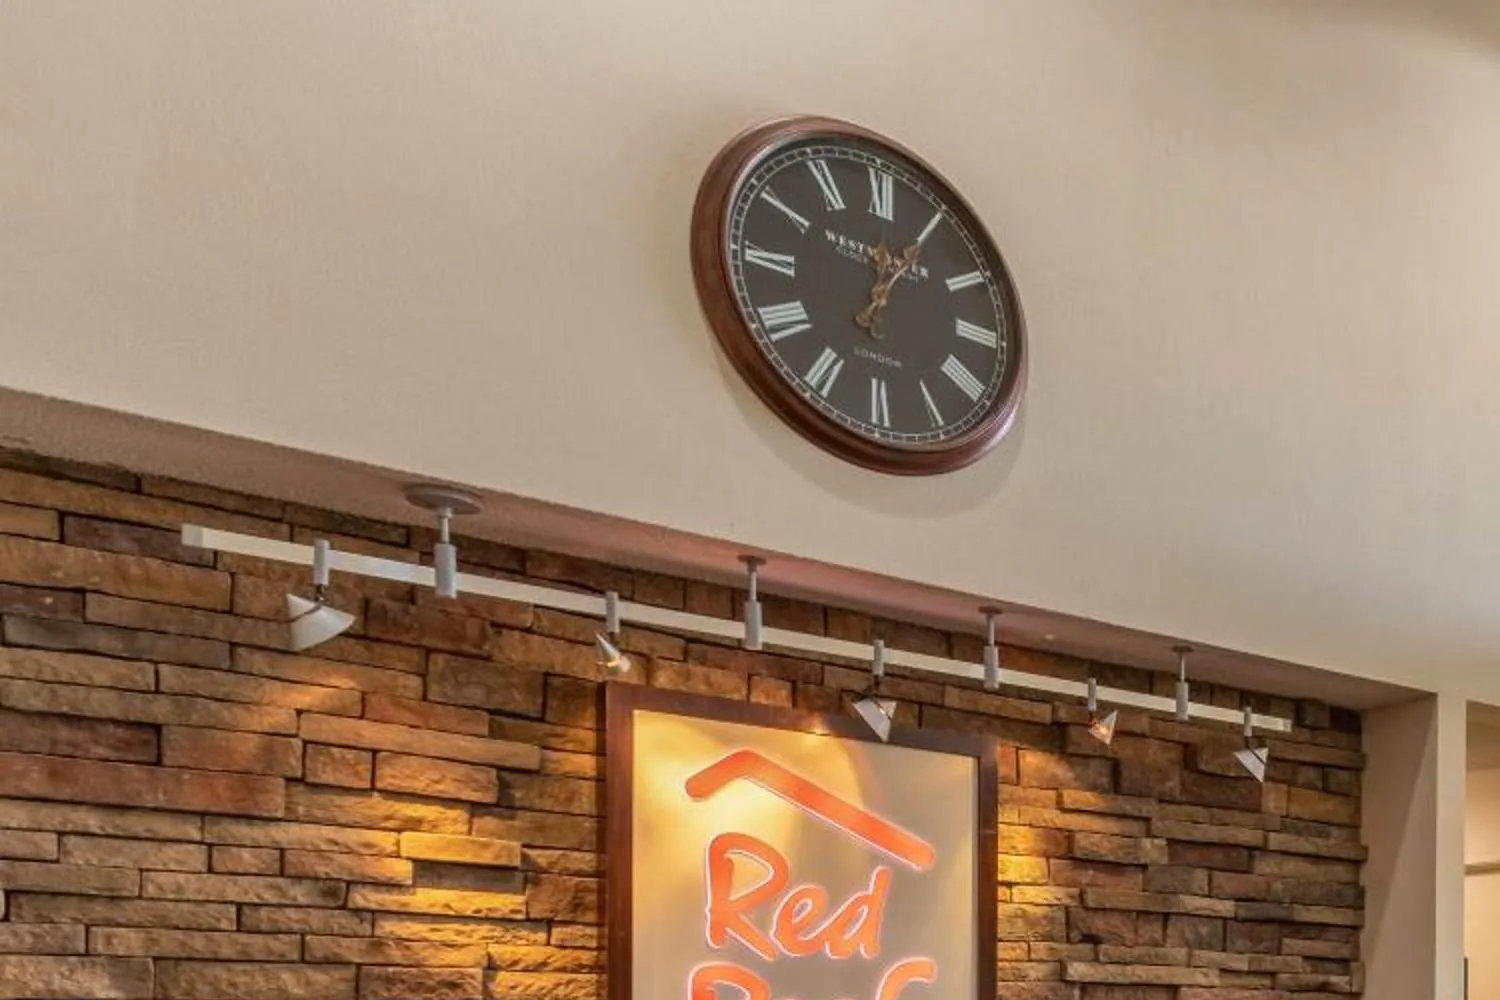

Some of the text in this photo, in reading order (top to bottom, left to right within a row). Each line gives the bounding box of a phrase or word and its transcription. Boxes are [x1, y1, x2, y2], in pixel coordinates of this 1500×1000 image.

[869, 166, 893, 221] XII
[956, 318, 997, 349] III
[705, 832, 892, 961] Red
